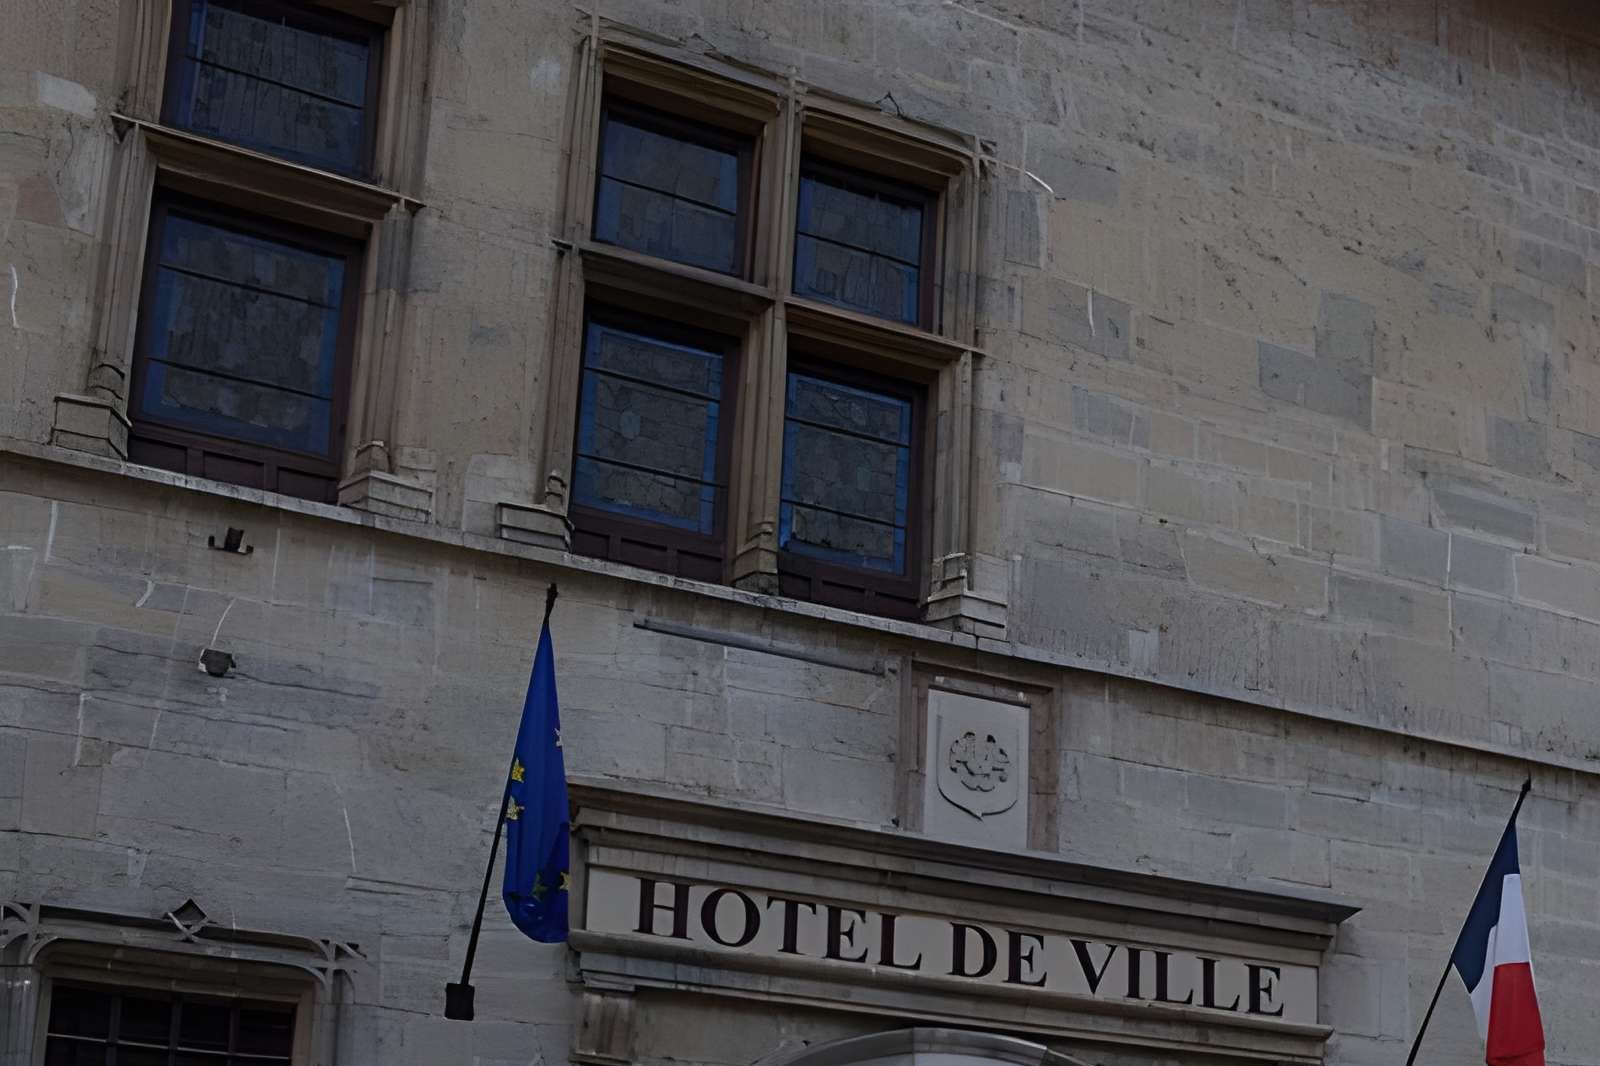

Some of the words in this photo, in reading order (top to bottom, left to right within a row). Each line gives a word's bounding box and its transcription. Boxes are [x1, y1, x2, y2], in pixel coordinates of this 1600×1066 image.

[633, 877, 922, 971] HOTEL
[947, 921, 1047, 987] DE
[1069, 938, 1285, 1017] VILLE
